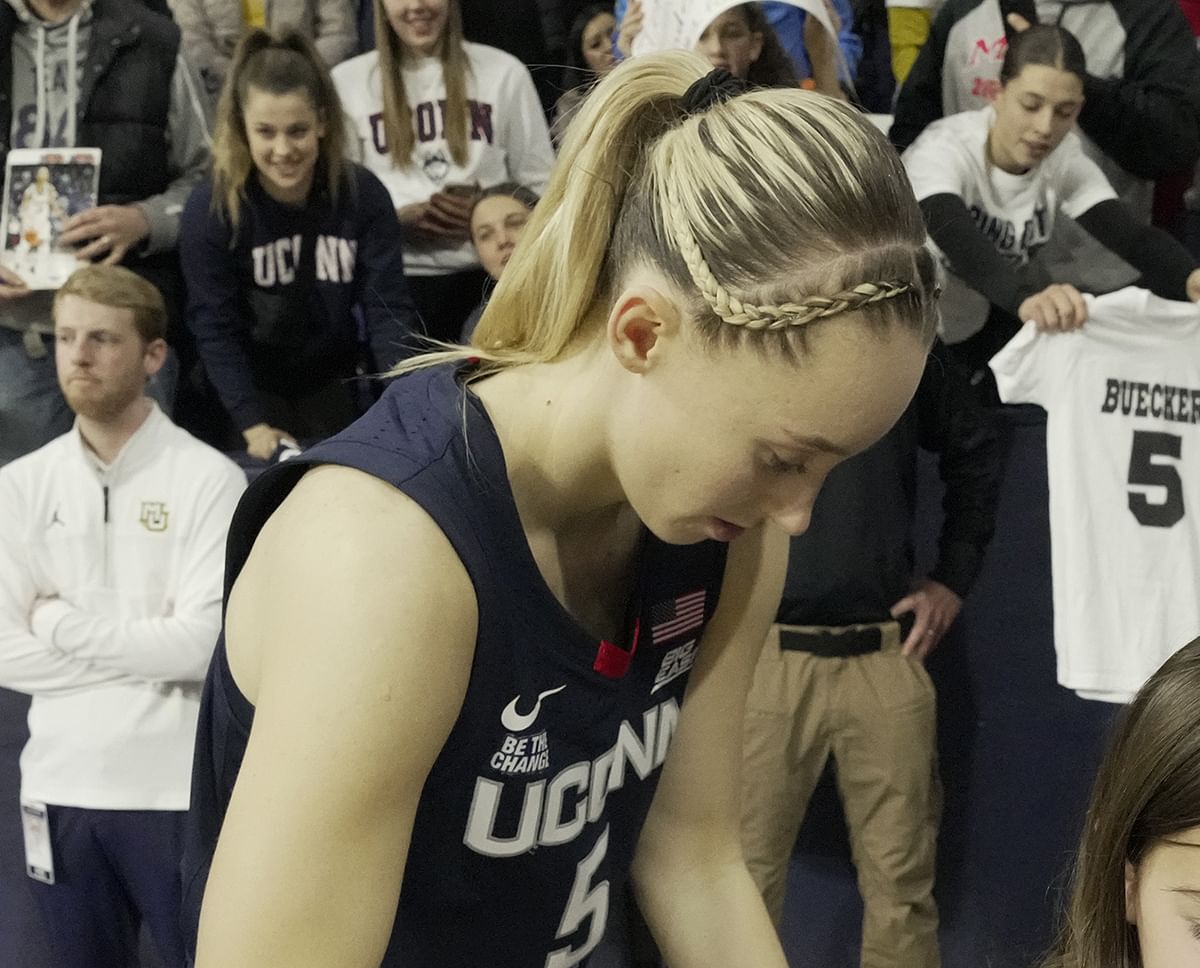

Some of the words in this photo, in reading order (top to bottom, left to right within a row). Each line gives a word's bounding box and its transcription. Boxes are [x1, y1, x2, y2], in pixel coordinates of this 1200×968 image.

[369, 98, 494, 155] UON
[1128, 430, 1185, 528] 5
[501, 735, 529, 756] BE
[531, 731, 548, 755] TH
